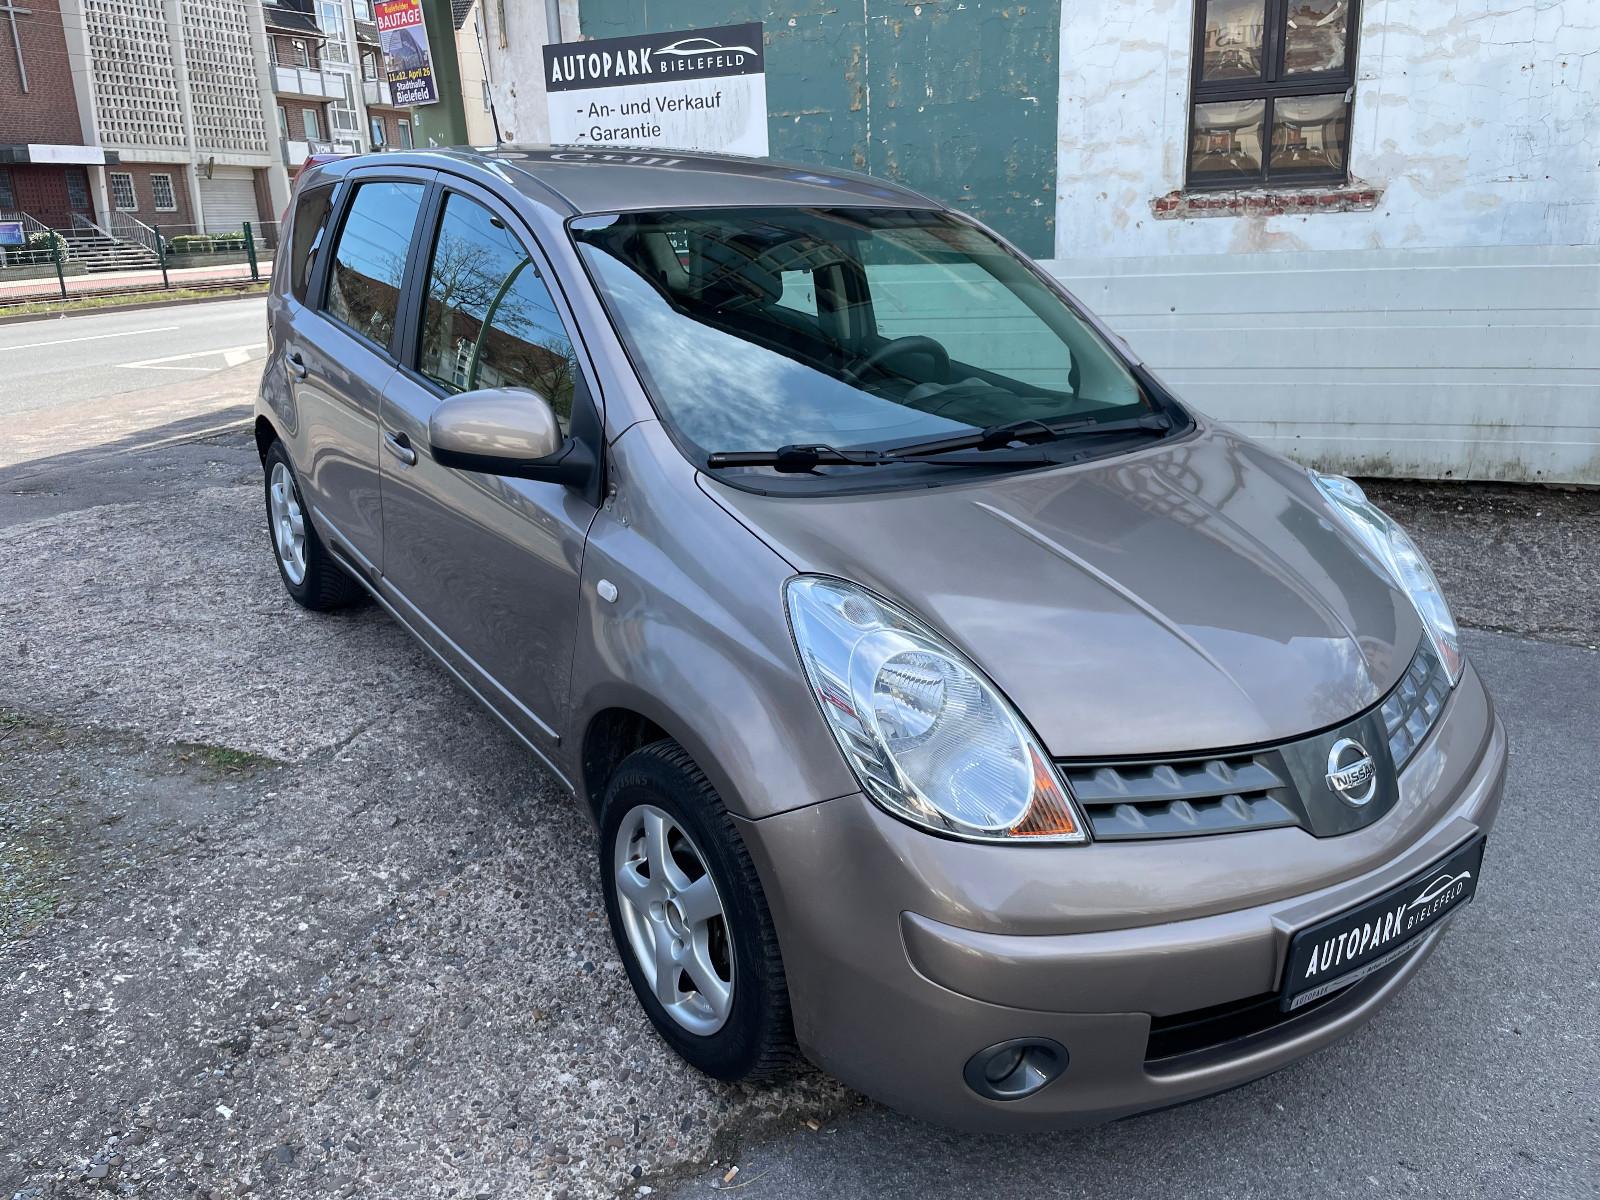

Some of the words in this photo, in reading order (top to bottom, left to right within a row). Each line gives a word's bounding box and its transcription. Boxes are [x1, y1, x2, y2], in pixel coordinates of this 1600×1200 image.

[377, 8, 420, 30] BAUTAGE
[408, 69, 422, 80] April
[423, 67, 431, 77] 26
[551, 47, 653, 83] AUTOPARK
[660, 54, 745, 73] BIELEFELD
[396, 79, 426, 91] Stadthalle
[396, 88, 430, 103] Bielefeld
[588, 101, 616, 118] An-
[620, 97, 650, 116] und
[655, 91, 722, 113] Verkauf
[590, 122, 661, 142] Garantie
[1336, 761, 1377, 788] NISSAN
[1304, 904, 1407, 979] AUTOPARK
[1407, 881, 1464, 930] BIELEFELD
[1295, 985, 1329, 1007] AUTOPARK
